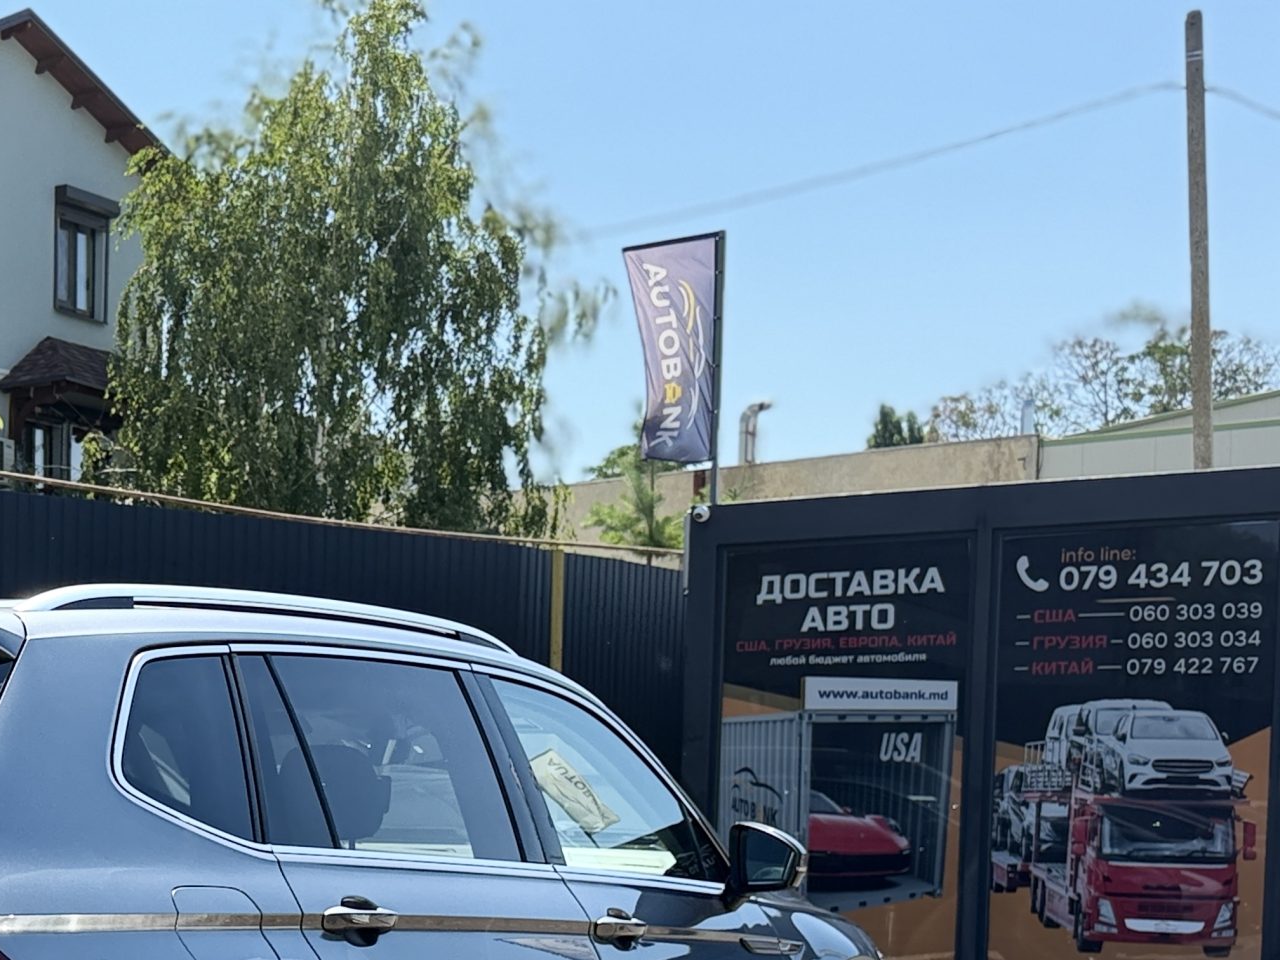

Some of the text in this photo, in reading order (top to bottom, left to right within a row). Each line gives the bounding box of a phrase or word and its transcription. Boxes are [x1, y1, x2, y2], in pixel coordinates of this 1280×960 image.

[1060, 546, 1137, 564] info line:
[1058, 558, 1263, 591] 079 434 703
[756, 566, 945, 605] ДОСТАВКА
[800, 603, 895, 632] АВТО
[1033, 609, 1076, 624] США
[1129, 602, 1263, 622] 060 303 039
[907, 632, 957, 647] КИТАЙ
[1032, 634, 1108, 650] ГРУЗИЯ
[1127, 630, 1261, 649] 060 303 034
[769, 651, 927, 666] любой бюджет автомобиля
[1031, 657, 1094, 676] КИТАЙ
[1126, 656, 1259, 676] 079 422 767
[818, 688, 949, 702] www.autobank.md
[879, 732, 922, 763] USA
